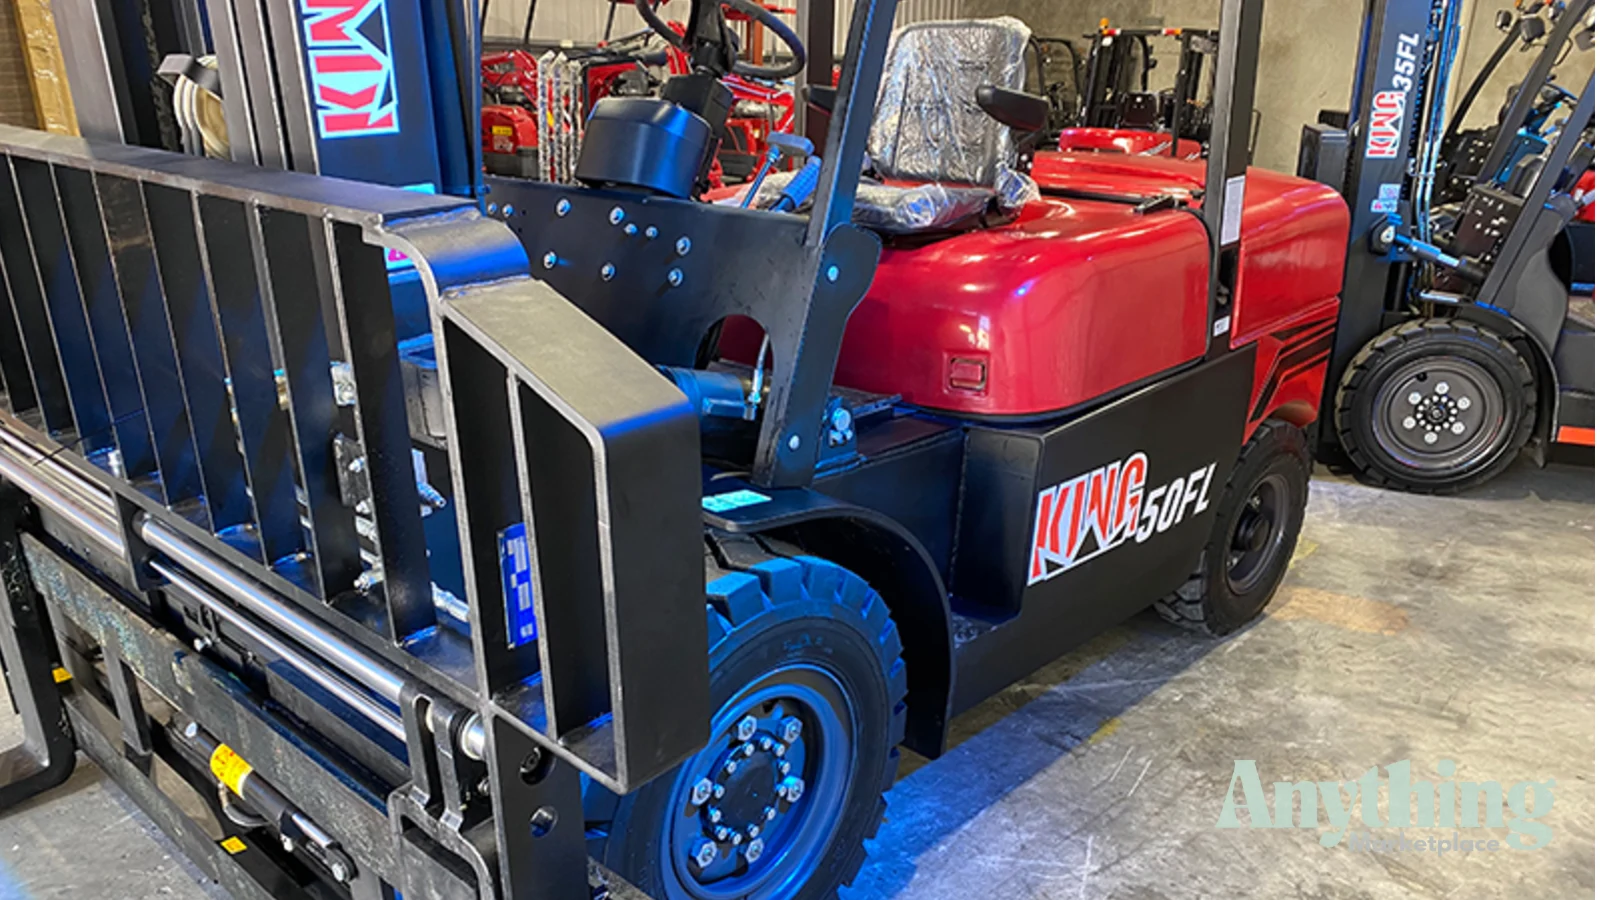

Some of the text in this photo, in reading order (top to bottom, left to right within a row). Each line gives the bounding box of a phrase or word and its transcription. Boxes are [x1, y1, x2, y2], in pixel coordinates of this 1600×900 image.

[1365, 90, 1406, 159] KING
[1392, 33, 1420, 93] 35FL
[1027, 452, 1217, 586] KING 50FL
